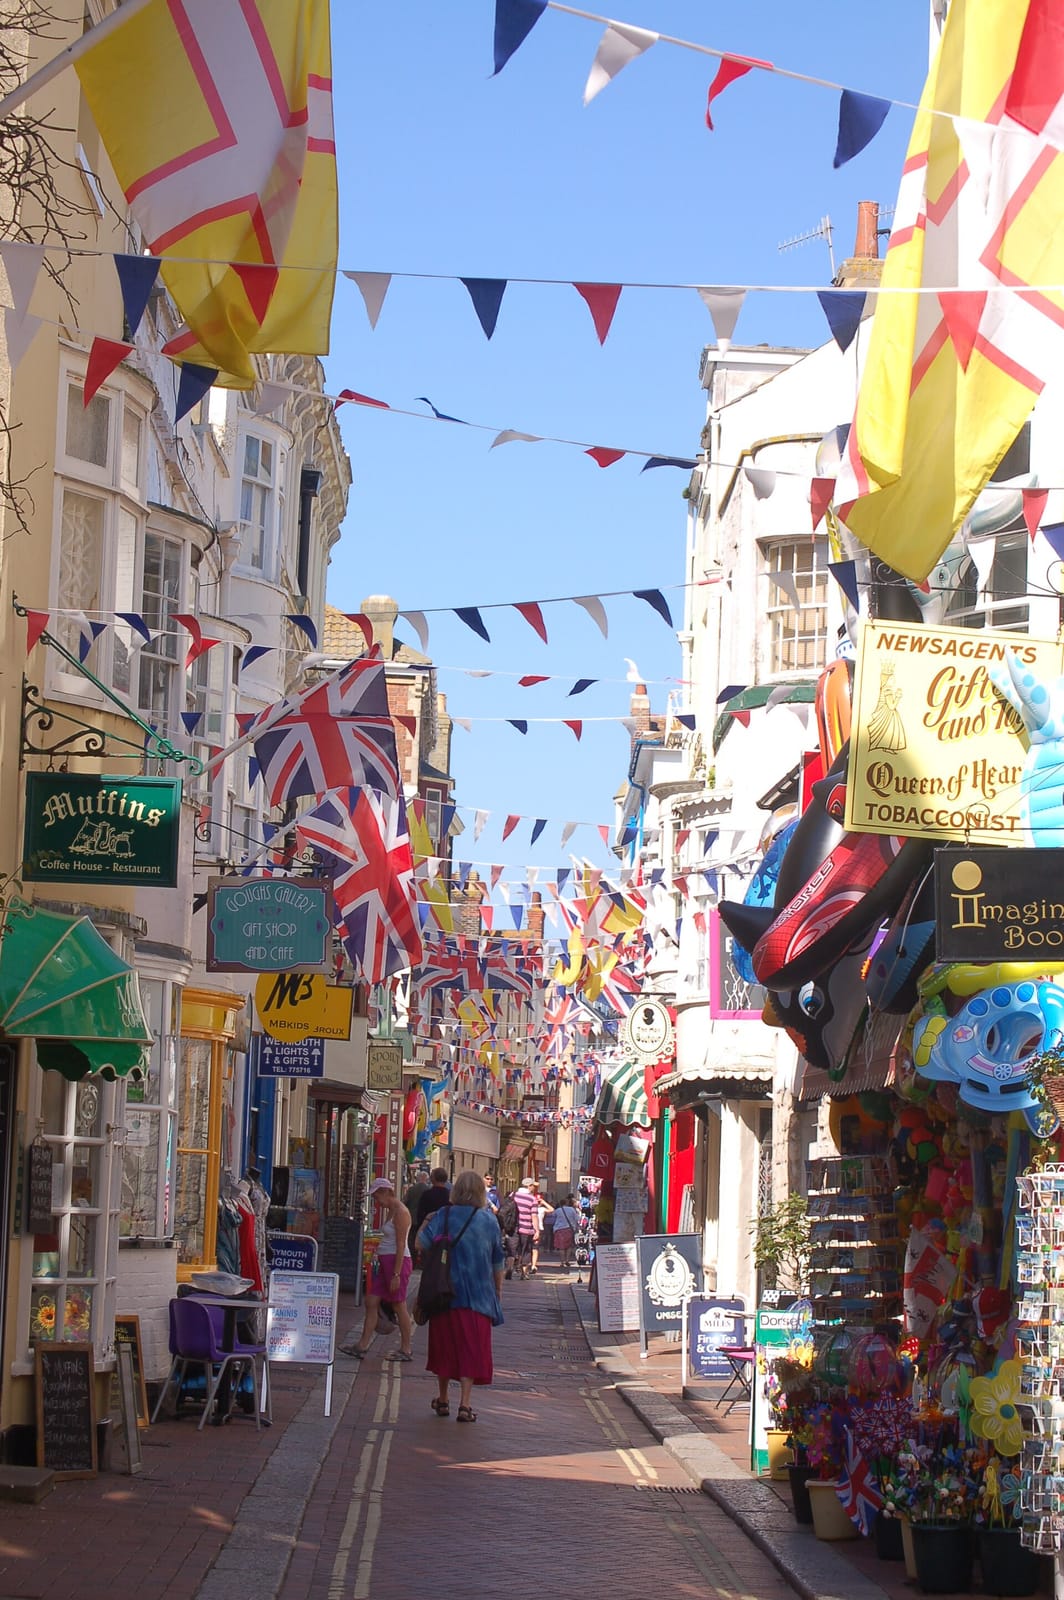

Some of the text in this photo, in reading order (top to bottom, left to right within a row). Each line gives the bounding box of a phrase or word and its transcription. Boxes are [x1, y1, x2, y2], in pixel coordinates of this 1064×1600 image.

[877, 633, 1037, 663] NEWSAGENTS
[938, 701, 1025, 741] and Toy
[866, 758, 1022, 800] Queen of Hear
[42, 789, 166, 828] Muffins
[865, 803, 1021, 832] TOBACCONIST
[40, 859, 70, 870] Coffee
[73, 861, 102, 871] House
[113, 863, 160, 874] Restaurant
[226, 885, 317, 914] GOUGHS GALLERY
[243, 923, 297, 938] GIFT SHOP
[1004, 925, 1064, 949] Boo
[245, 946, 294, 960] AND CAFE
[275, 1047, 309, 1056] LIGHTS
[274, 1056, 310, 1065] & GIFTS
[308, 1305, 333, 1316] BAGELS
[308, 1315, 332, 1326] TOASTIES
[761, 1315, 798, 1326] Dorse
[721, 1335, 737, 1344] Tea
[696, 1344, 705, 1353] &
